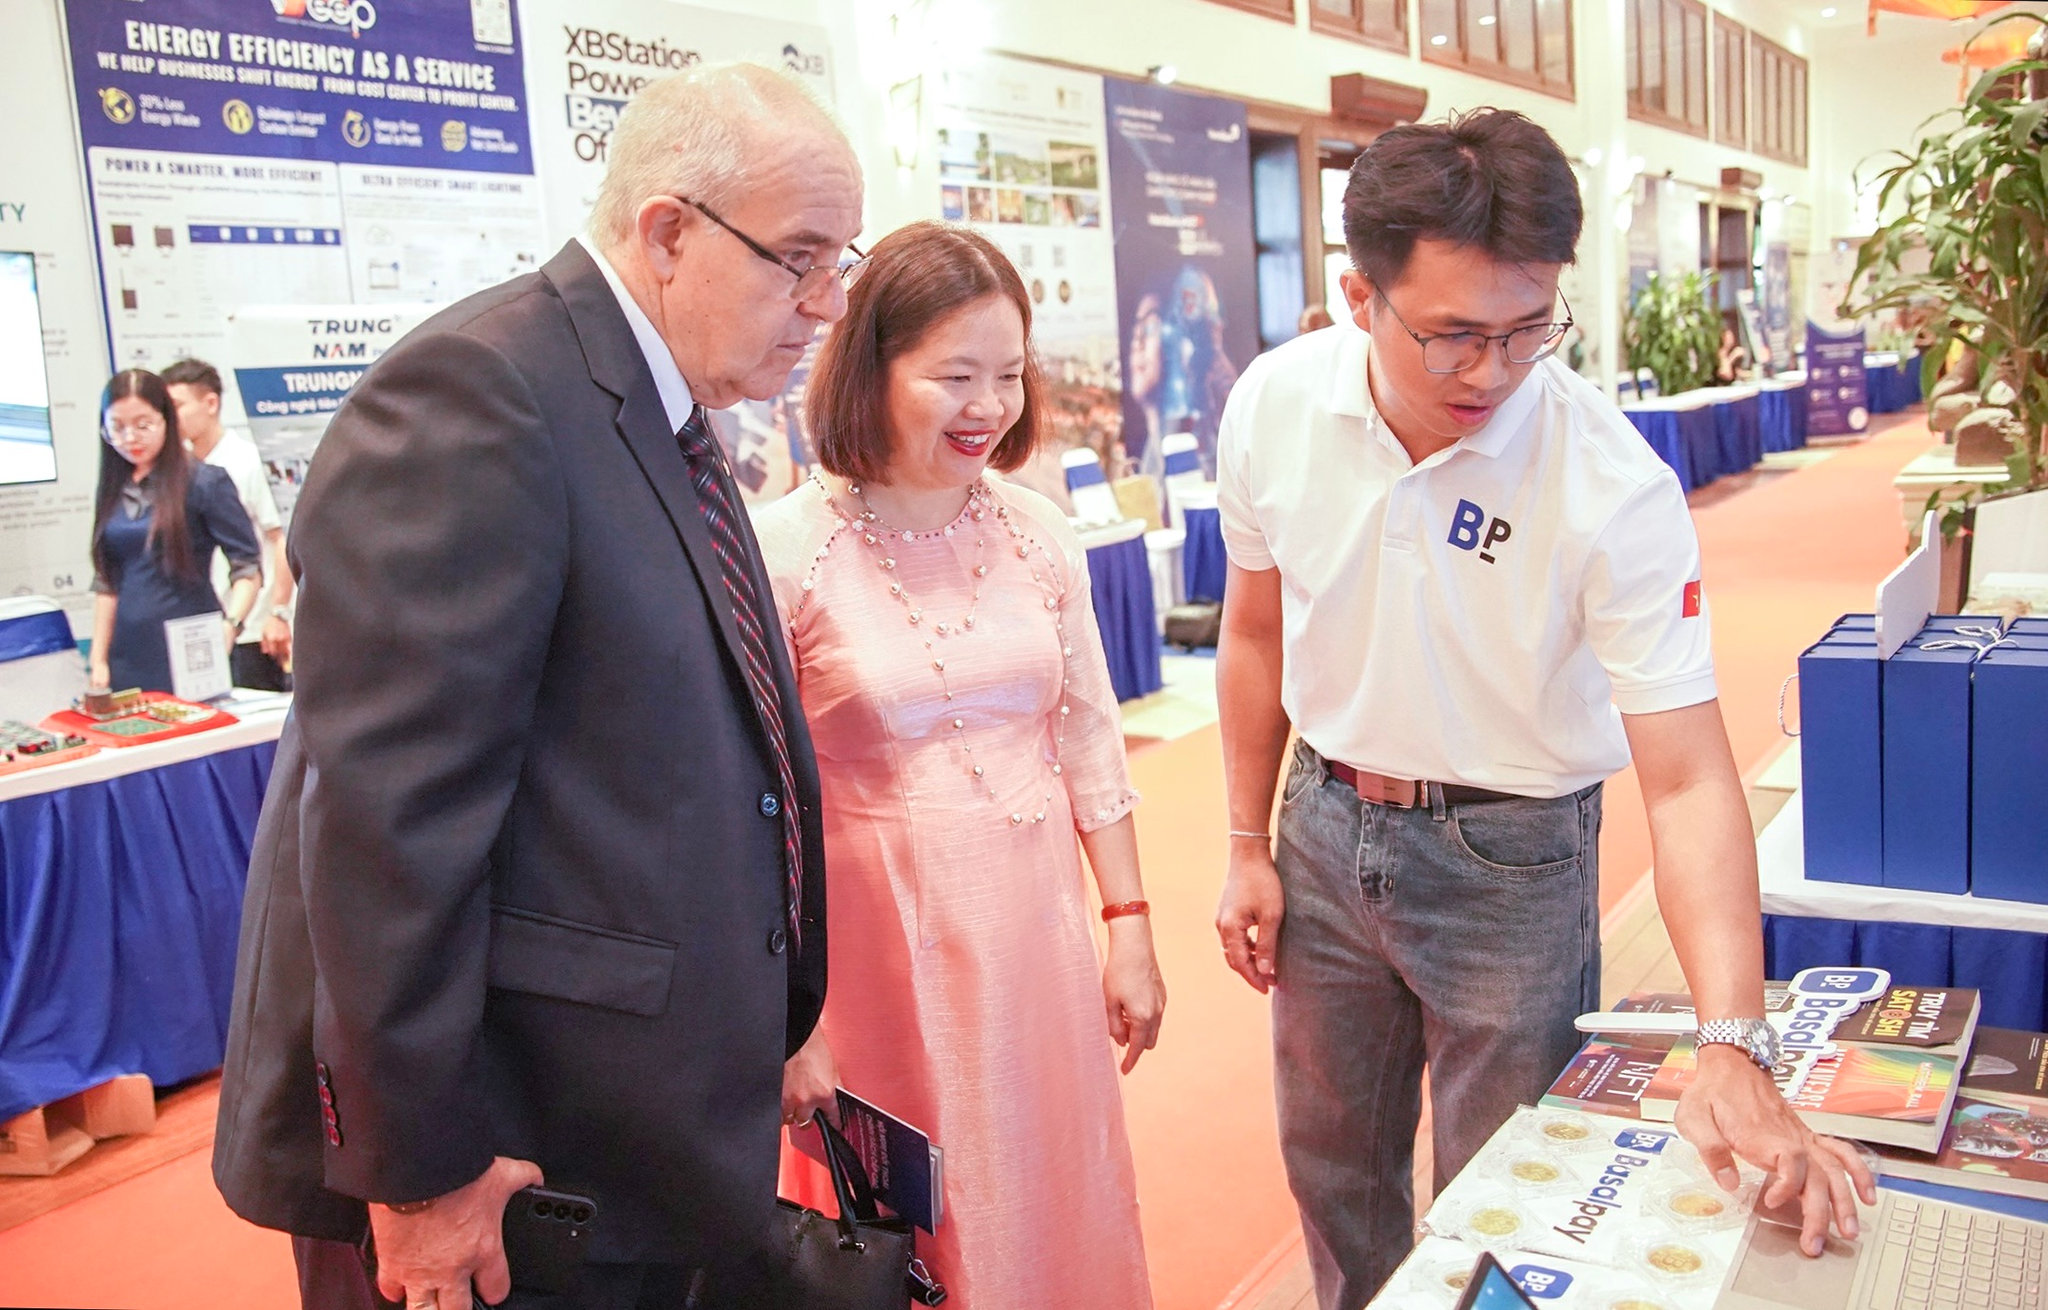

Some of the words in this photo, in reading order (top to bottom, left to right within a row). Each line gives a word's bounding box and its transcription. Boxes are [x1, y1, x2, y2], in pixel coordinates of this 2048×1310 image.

[125, 20, 221, 59] ENERGY
[228, 33, 355, 75] EFFICIENCY
[362, 50, 390, 79] AS
[395, 54, 410, 81] A
[414, 56, 496, 91] SERVICE
[564, 25, 702, 70] XBStation
[97, 52, 119, 70] WE
[120, 54, 155, 73] HELP
[157, 58, 236, 82] BUSINESSES
[236, 67, 271, 86] SHIFT
[273, 70, 318, 90] ENERGY
[323, 76, 355, 95] FROM
[356, 80, 385, 98] COST
[386, 83, 426, 102] CENTER
[427, 87, 441, 104] TO
[442, 89, 478, 108] PROFIT
[568, 62, 653, 95] Powe
[106, 158, 150, 173] POWER
[156, 161, 163, 174] A
[308, 319, 392, 334] TRUNG
[313, 343, 366, 359] NAM
[1873, 990, 1918, 1037] SATOSHI
[1915, 992, 1947, 1020] TRUY
[1905, 1020, 1940, 1040] TÌM
[1607, 1061, 1662, 1101] NFT
[1553, 1154, 1649, 1244] Basalpay
